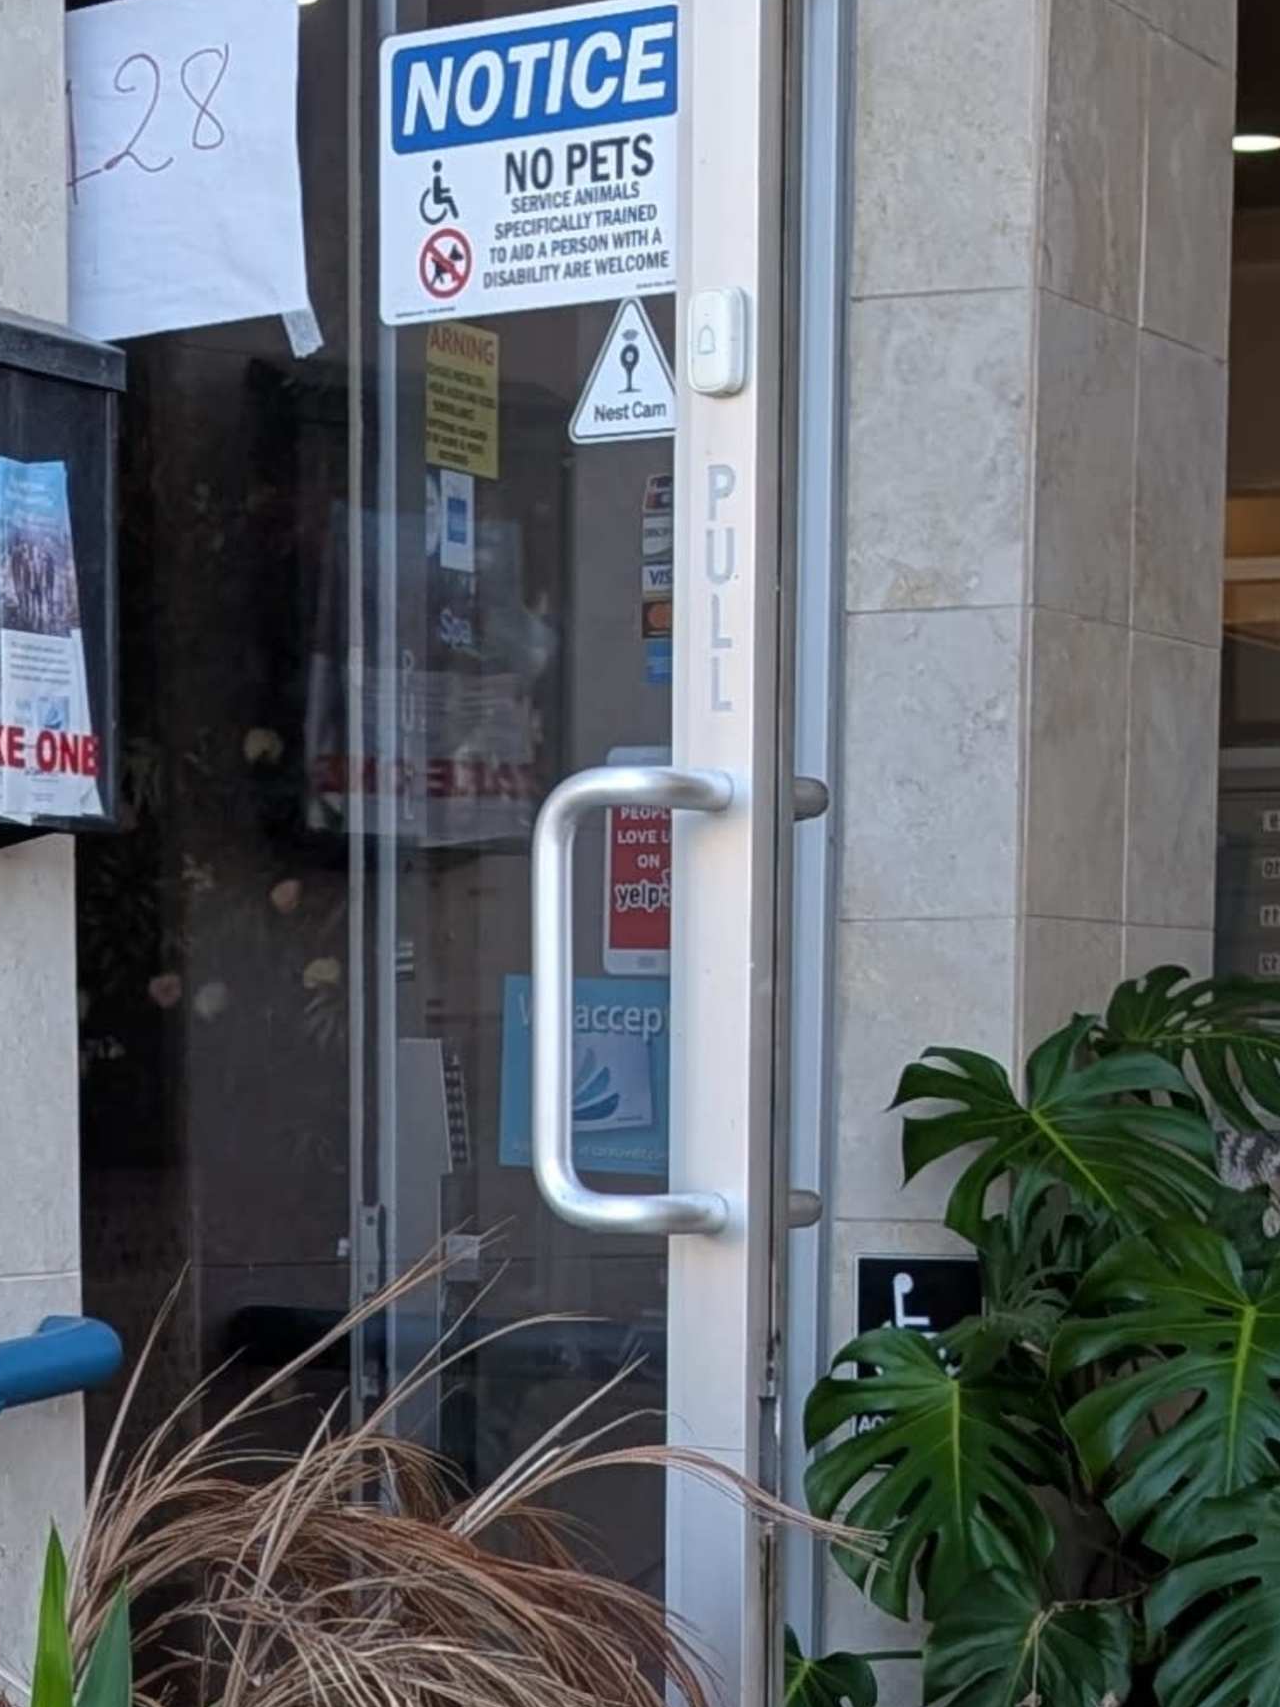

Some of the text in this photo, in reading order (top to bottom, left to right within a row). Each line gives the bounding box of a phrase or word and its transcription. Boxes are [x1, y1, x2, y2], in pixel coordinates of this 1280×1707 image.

[402, 21, 674, 137] NOTICE
[505, 133, 655, 195] NO PETS
[511, 181, 641, 215] SERVICE ANIMALS
[494, 203, 658, 241] SPECIFICALLY TRAINED
[489, 226, 663, 265] TO AID A PERSON WITH A
[483, 250, 671, 290] DISABILITY ARE WELCOME
[427, 325, 496, 367] ARNING
[593, 399, 667, 423] Nest Cam
[705, 463, 737, 712] PULL
[35, 730, 101, 777] ONE
[620, 804, 671, 820] PEOPL
[616, 829, 658, 845] LOVE
[637, 854, 661, 869] ON
[615, 879, 662, 912] yelp
[574, 1003, 664, 1043] accep
